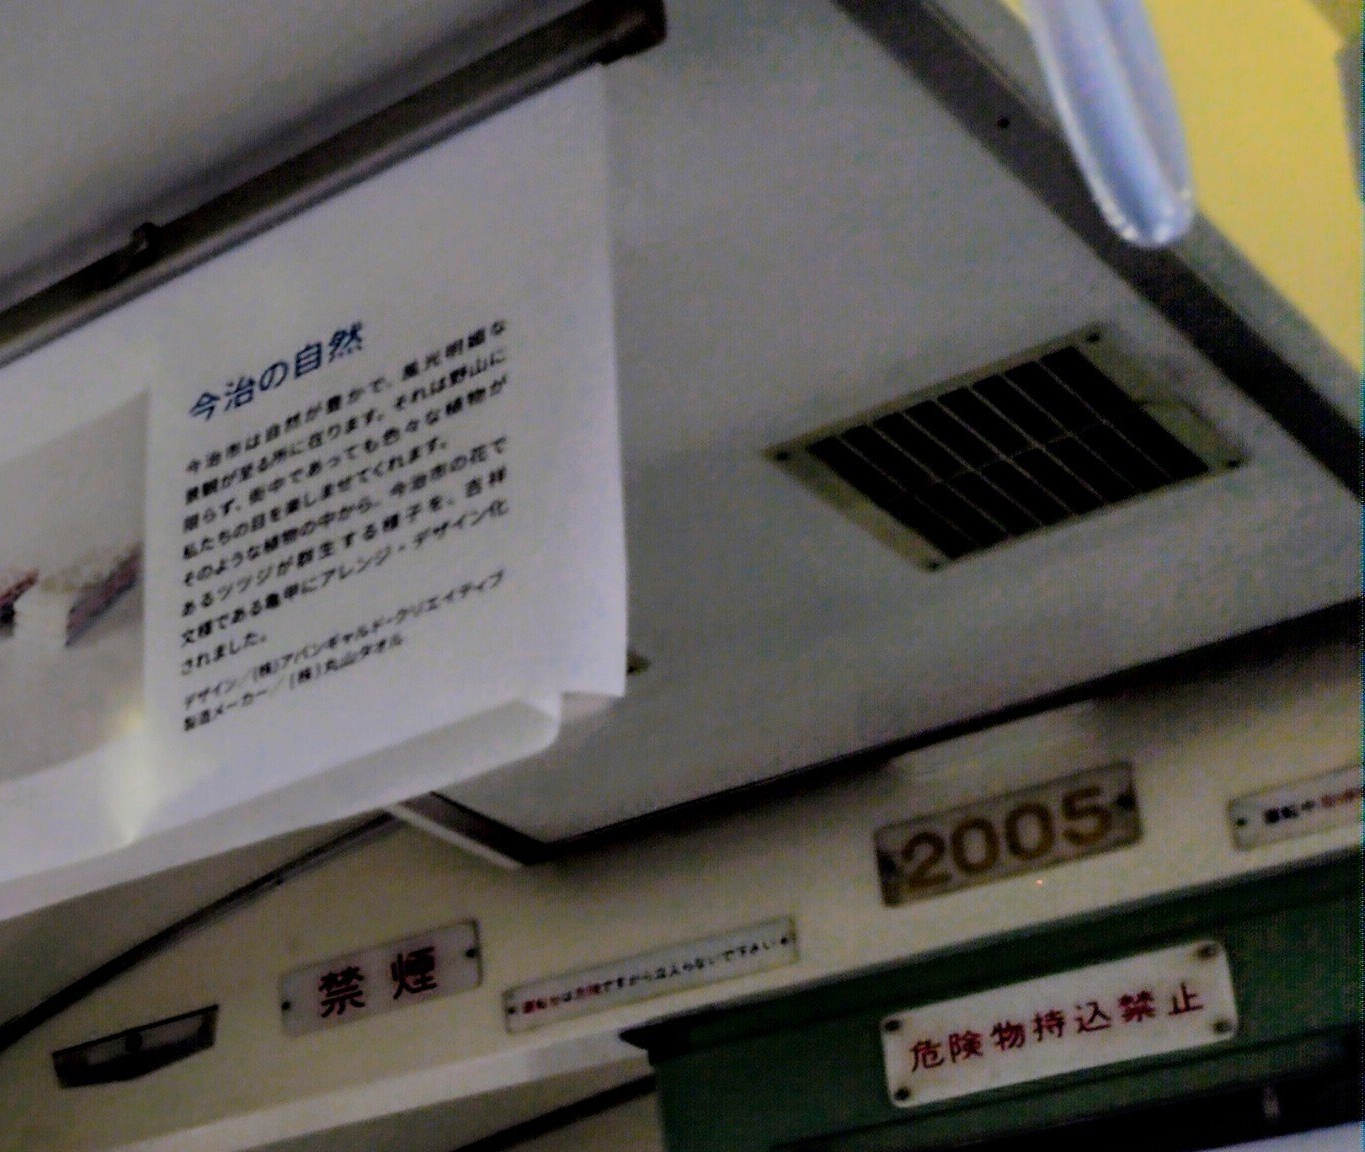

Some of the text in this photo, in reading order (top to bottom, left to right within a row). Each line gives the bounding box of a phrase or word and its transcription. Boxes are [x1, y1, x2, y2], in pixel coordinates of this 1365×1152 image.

[189, 319, 364, 422] 今治の自然
[901, 785, 1113, 889] 2005
[318, 946, 438, 1019] 禁煙
[909, 981, 1204, 1073] 危険物持込禁止
